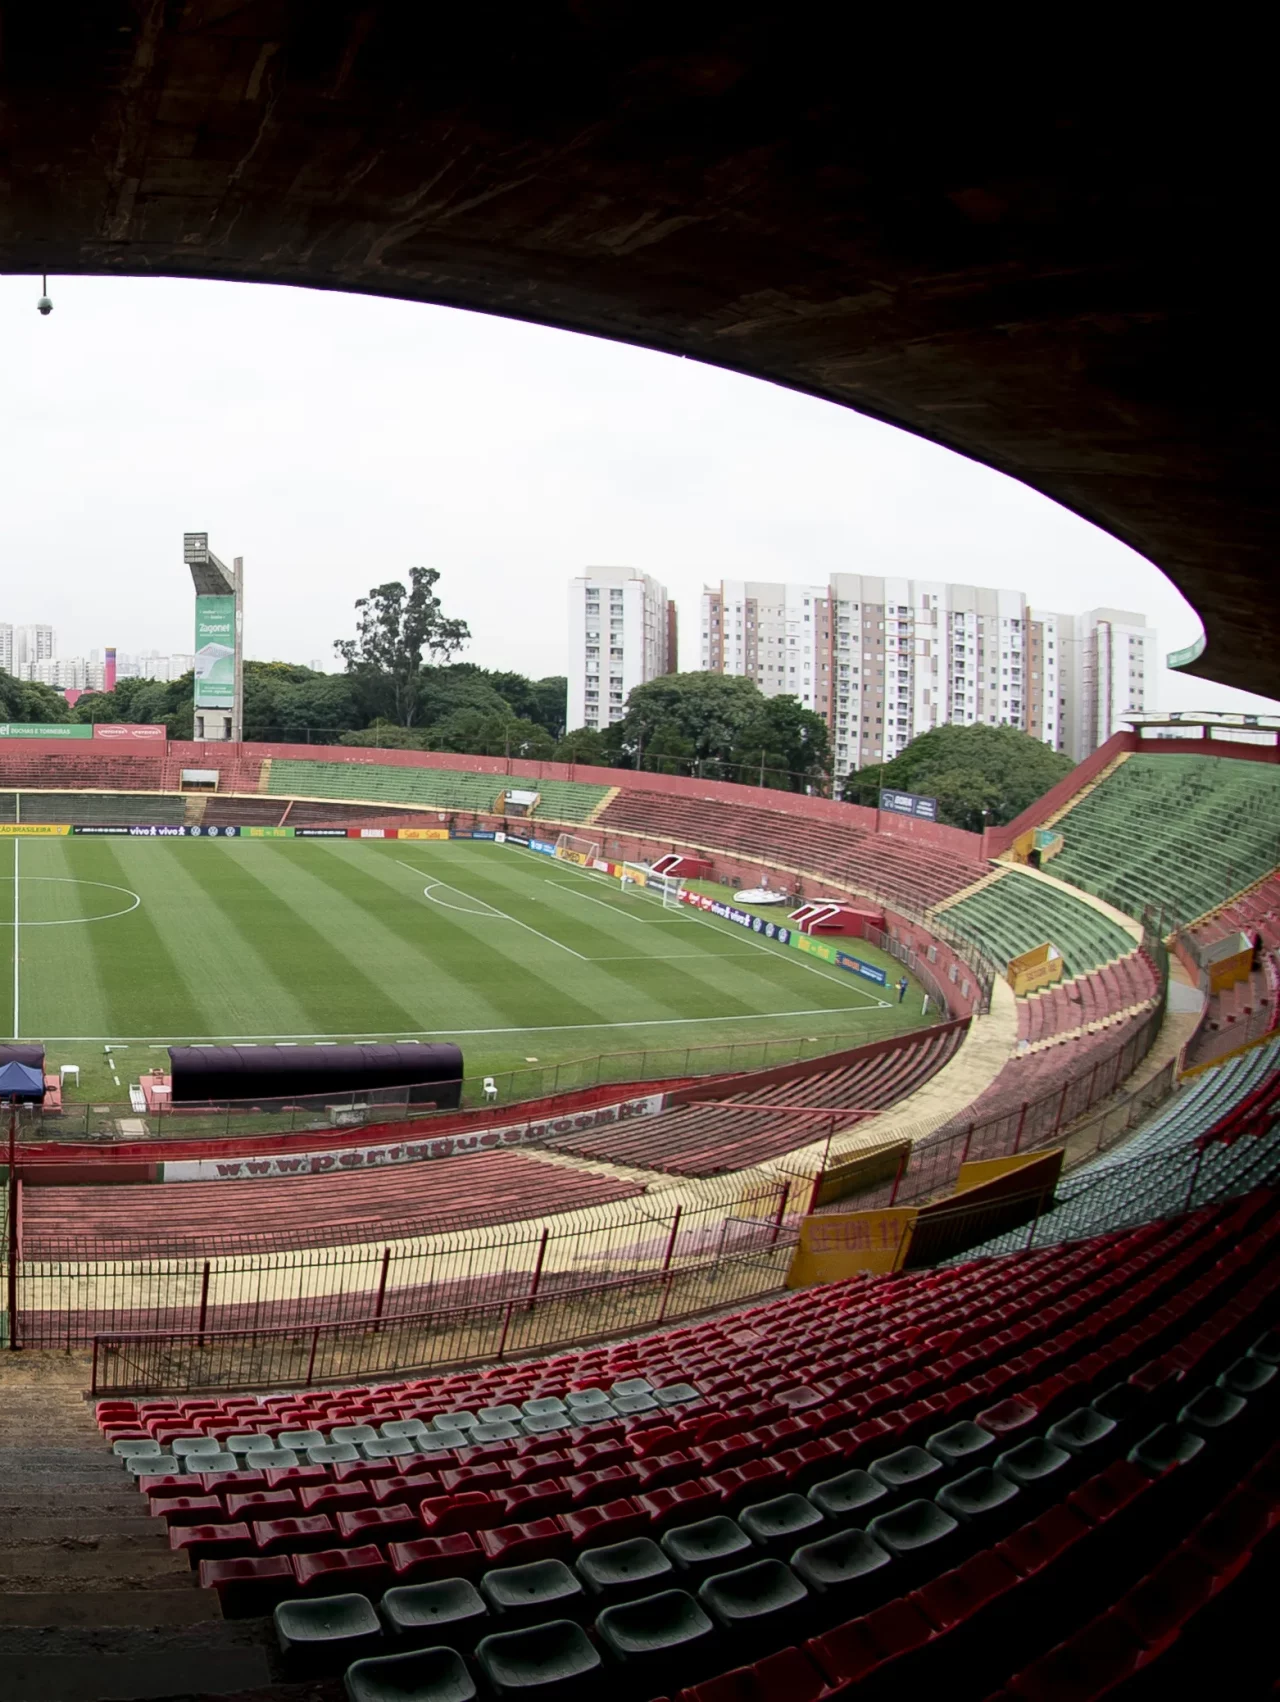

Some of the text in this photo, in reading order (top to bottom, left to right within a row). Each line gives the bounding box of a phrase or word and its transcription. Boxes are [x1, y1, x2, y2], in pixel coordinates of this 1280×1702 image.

[199, 623, 230, 633] Zagonel
[130, 826, 149, 835] vivo
[159, 826, 178, 835] vivo
[810, 1217, 900, 1253] SETOR 11
